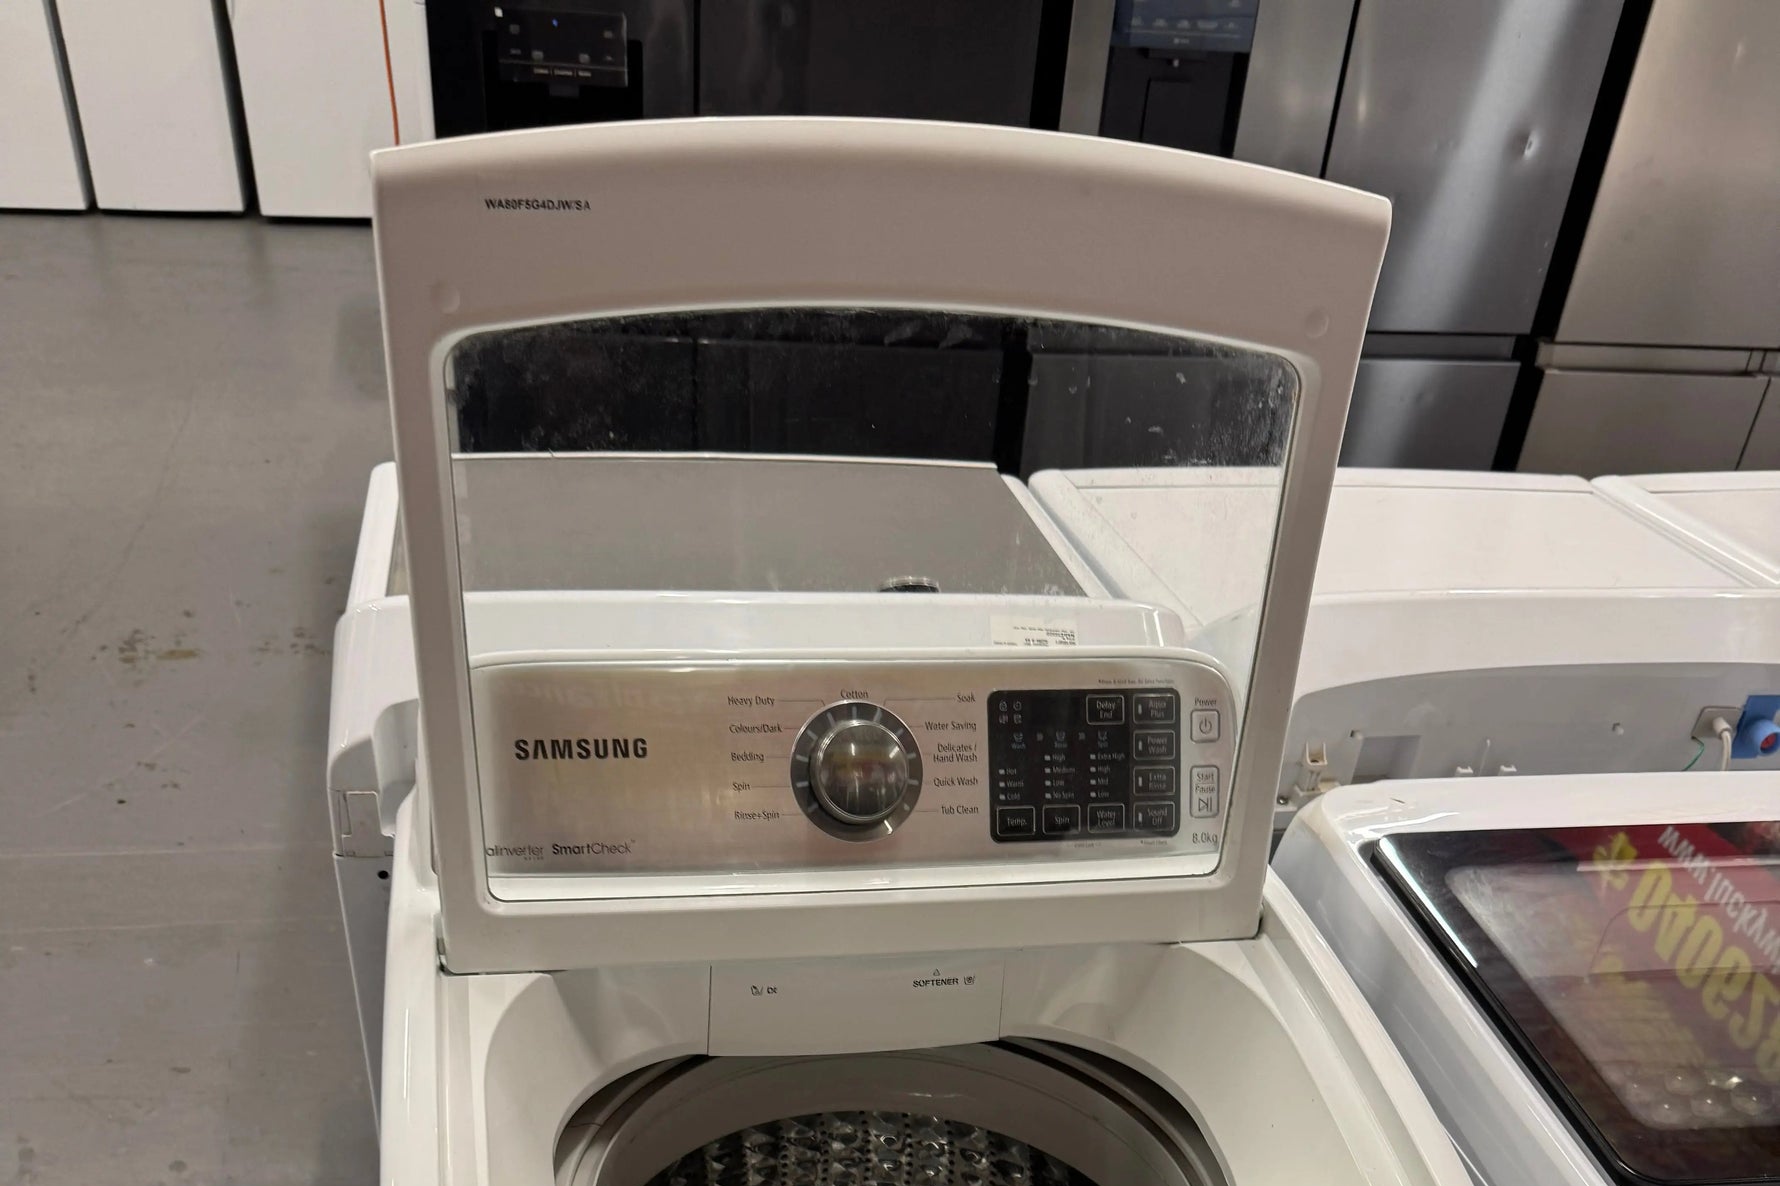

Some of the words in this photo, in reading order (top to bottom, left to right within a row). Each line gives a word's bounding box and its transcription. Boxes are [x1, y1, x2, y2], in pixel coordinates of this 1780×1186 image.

[840, 690, 869, 700] Cotton
[956, 693, 976, 703] Soak
[727, 695, 753, 708] Heavy
[755, 695, 775, 707] Duty
[1096, 700, 1116, 711] Delay
[1194, 698, 1217, 707] Power
[1100, 709, 1113, 719] End
[728, 722, 783, 734] Colours/Dark
[924, 721, 949, 731] Water
[951, 720, 977, 732] Saving
[1147, 736, 1168, 745] Power
[514, 738, 648, 760] SAMSUNG
[937, 743, 973, 753] Delicates
[730, 751, 765, 763] Bedding
[933, 753, 954, 763] Hand
[956, 753, 978, 762] Wash
[933, 776, 956, 788] Quick
[957, 776, 979, 786] Wash
[1197, 773, 1215, 784] Start
[732, 782, 751, 793] Spin
[1195, 784, 1215, 794] Pause
[941, 805, 955, 815] Tub
[956, 804, 979, 814] Clean
[734, 809, 780, 822] Rinse+Spin
[1054, 815, 1071, 825] Spin
[1192, 831, 1218, 845] 8.0kg
[552, 841, 632, 856] SmartCheck
[913, 978, 959, 988] SOFTENER
